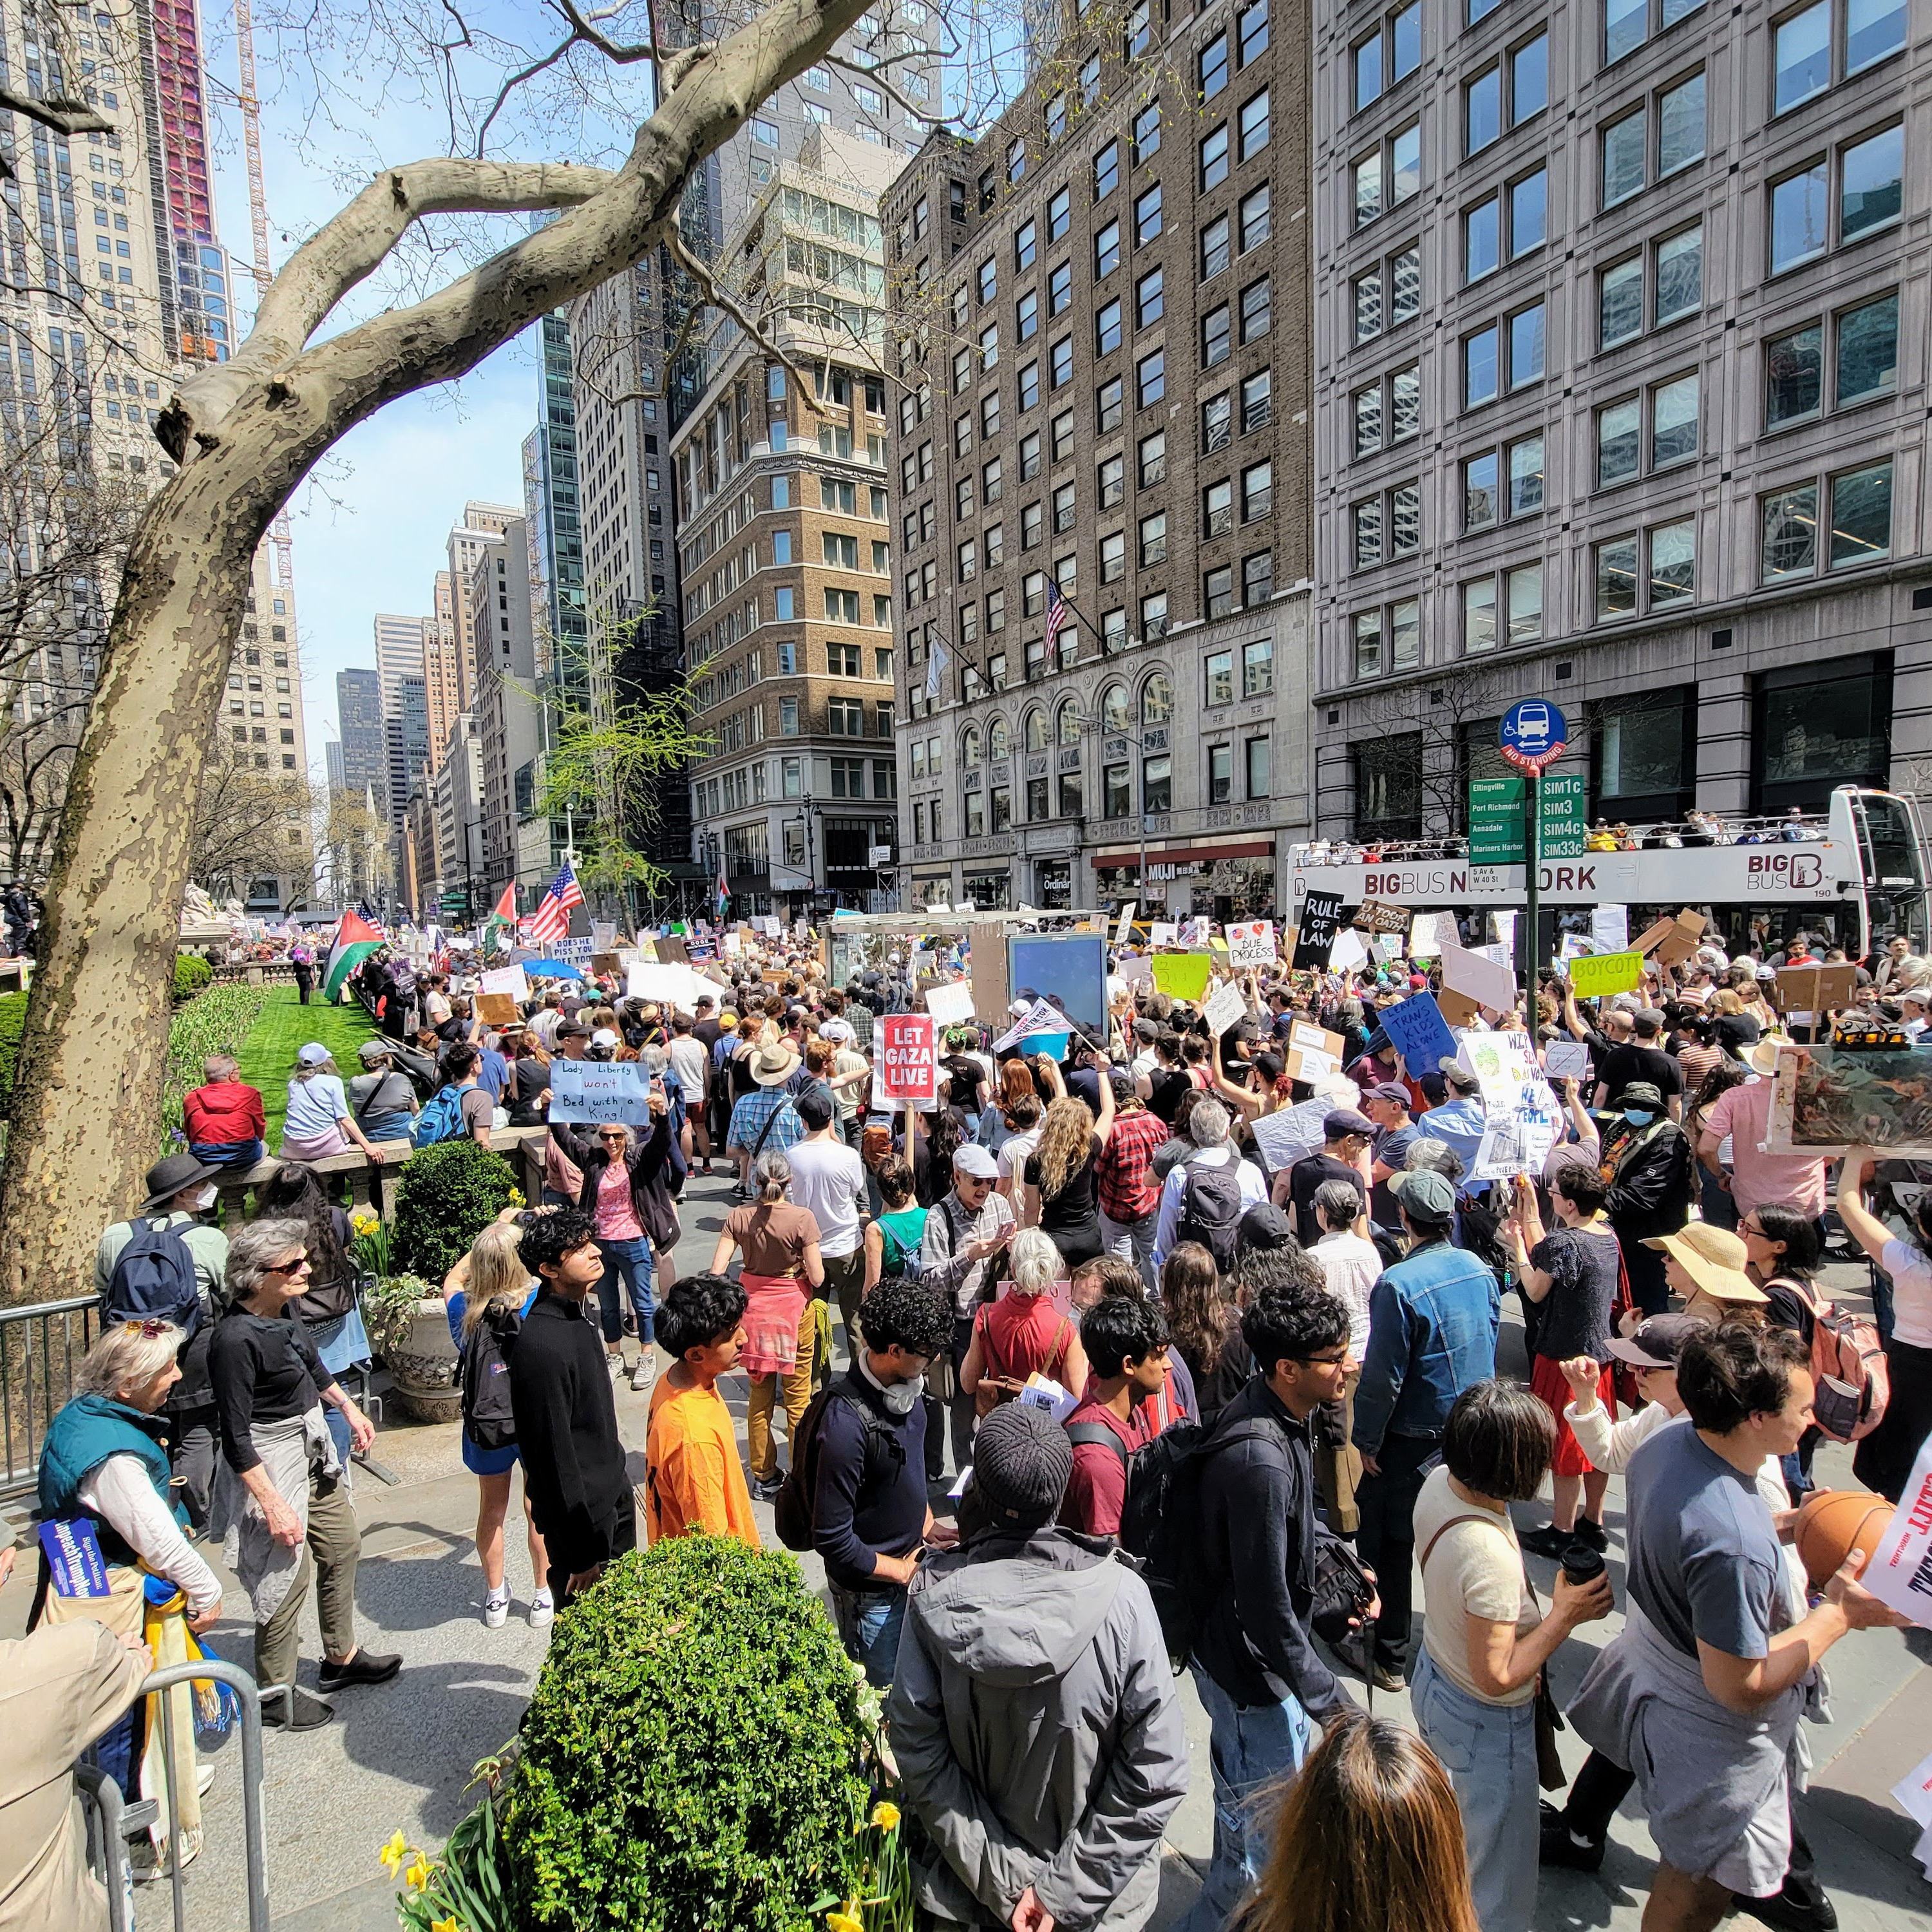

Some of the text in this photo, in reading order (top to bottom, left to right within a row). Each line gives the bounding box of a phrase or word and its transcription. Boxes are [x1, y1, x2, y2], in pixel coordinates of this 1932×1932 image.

[1505, 746, 1563, 766] NO STANDING
[1472, 782, 1506, 793] Eltingville
[1472, 802, 1520, 813] Port Richmond
[1544, 799, 1573, 816] SIM3
[1472, 824, 1503, 833] Annadale
[1472, 843, 1524, 853] Mariners Harbor
[1148, 863, 1176, 881] MUJI
[1748, 854, 1788, 873] BIG
[1043, 878, 1071, 889] Ordinar
[1539, 866, 1596, 891] ORK
[1747, 873, 1788, 890] BUS
[1814, 889, 1832, 898] 190
[1305, 898, 1342, 920] RULE
[1361, 903, 1408, 923] U TOOK
[1311, 919, 1330, 930] OF
[1354, 911, 1374, 924] AN
[1374, 917, 1405, 931] OATH
[556, 939, 578, 947] DOES
[1241, 938, 1263, 949] DUE
[1299, 927, 1335, 949] LAW
[554, 945, 592, 956] PISS YOU
[574, 955, 591, 963] TOO
[1231, 947, 1274, 963] PROCESS
[1575, 955, 1641, 978] BOYCOTT
[1385, 999, 1419, 1018] LEAVE
[1391, 1007, 1430, 1029] TRANS
[894, 1027, 923, 1045] LET
[1403, 1018, 1435, 1041] KIDS
[1406, 1031, 1441, 1053] ALONE
[886, 1047, 933, 1066] GAZA
[562, 1062, 631, 1075] Lady Liberty
[890, 1068, 928, 1086] LIVE
[584, 1078, 617, 1089] won't
[563, 1094, 584, 1106] Bed
[593, 1095, 618, 1106] with
[589, 1106, 623, 1121] King!
[82, 1536, 92, 1553] Sign
[88, 1551, 97, 1564] the
